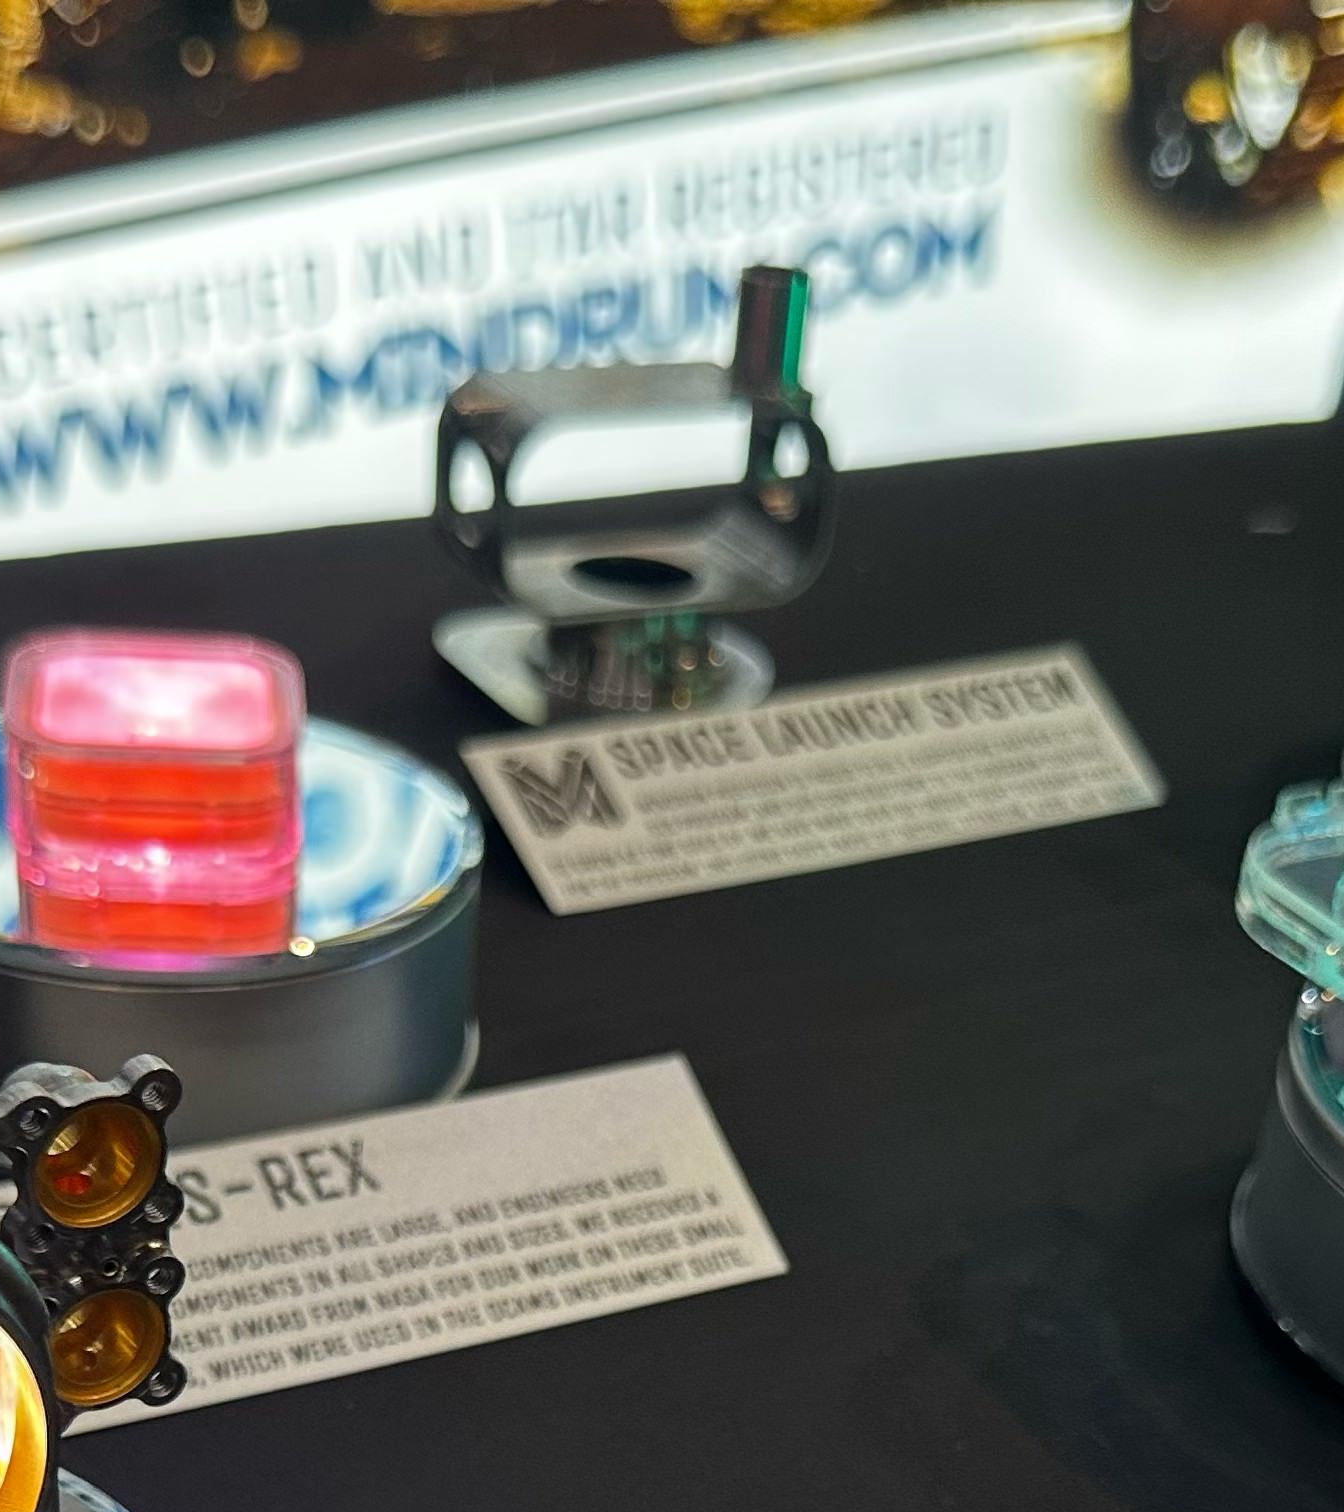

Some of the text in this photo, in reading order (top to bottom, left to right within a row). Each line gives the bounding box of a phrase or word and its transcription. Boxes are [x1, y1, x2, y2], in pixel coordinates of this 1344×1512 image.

[601, 723, 756, 781] SPACE
[748, 696, 923, 756] LAUNCH
[917, 670, 1084, 729] SYSTEM
